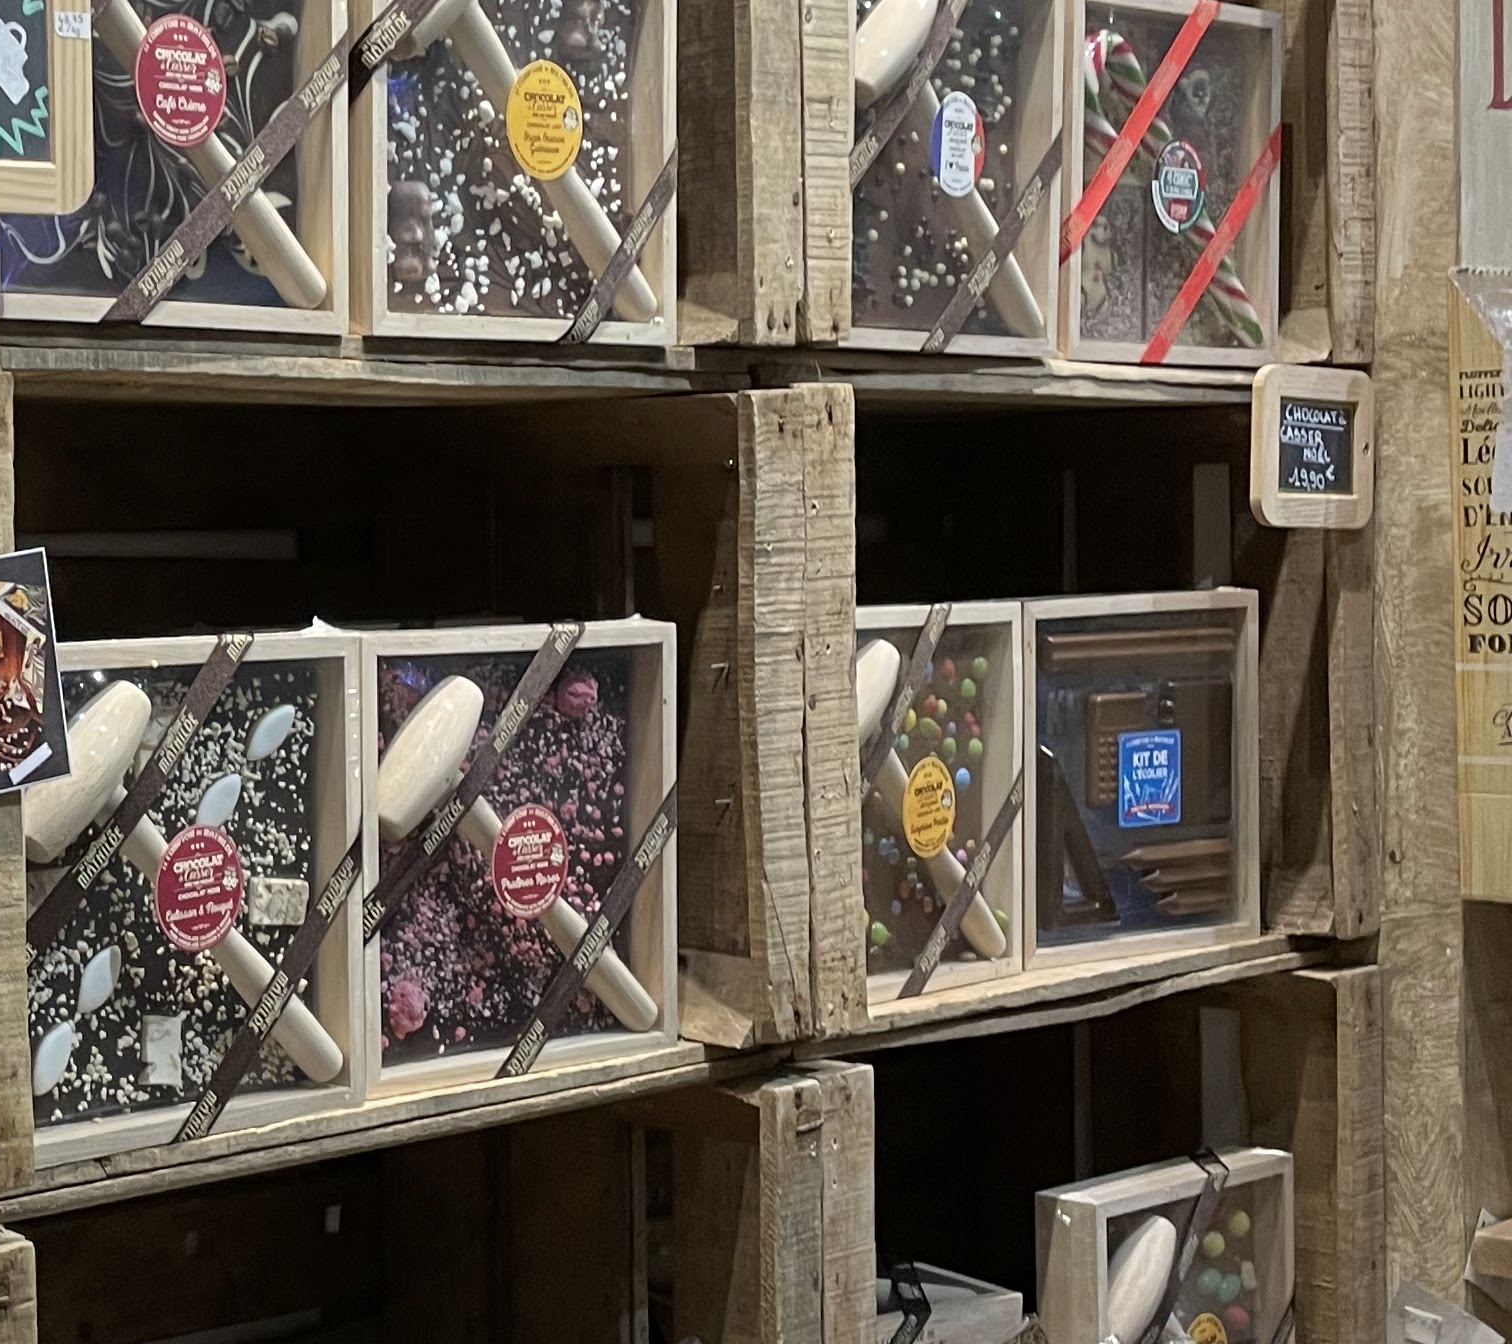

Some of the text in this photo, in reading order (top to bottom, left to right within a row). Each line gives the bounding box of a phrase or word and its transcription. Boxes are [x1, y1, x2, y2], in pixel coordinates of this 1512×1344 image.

[361, 12, 411, 69] MATHILDE
[155, 48, 207, 64] CHOCOLAT
[155, 94, 176, 113] Café
[1286, 404, 1337, 424] CHOCOLAT
[1280, 426, 1324, 449] CASSER
[159, 711, 199, 773] MATHILDE
[1133, 749, 1168, 767] KIT DE
[78, 826, 125, 889] MATHILDE
[173, 854, 223, 873] CHOCOLAT
